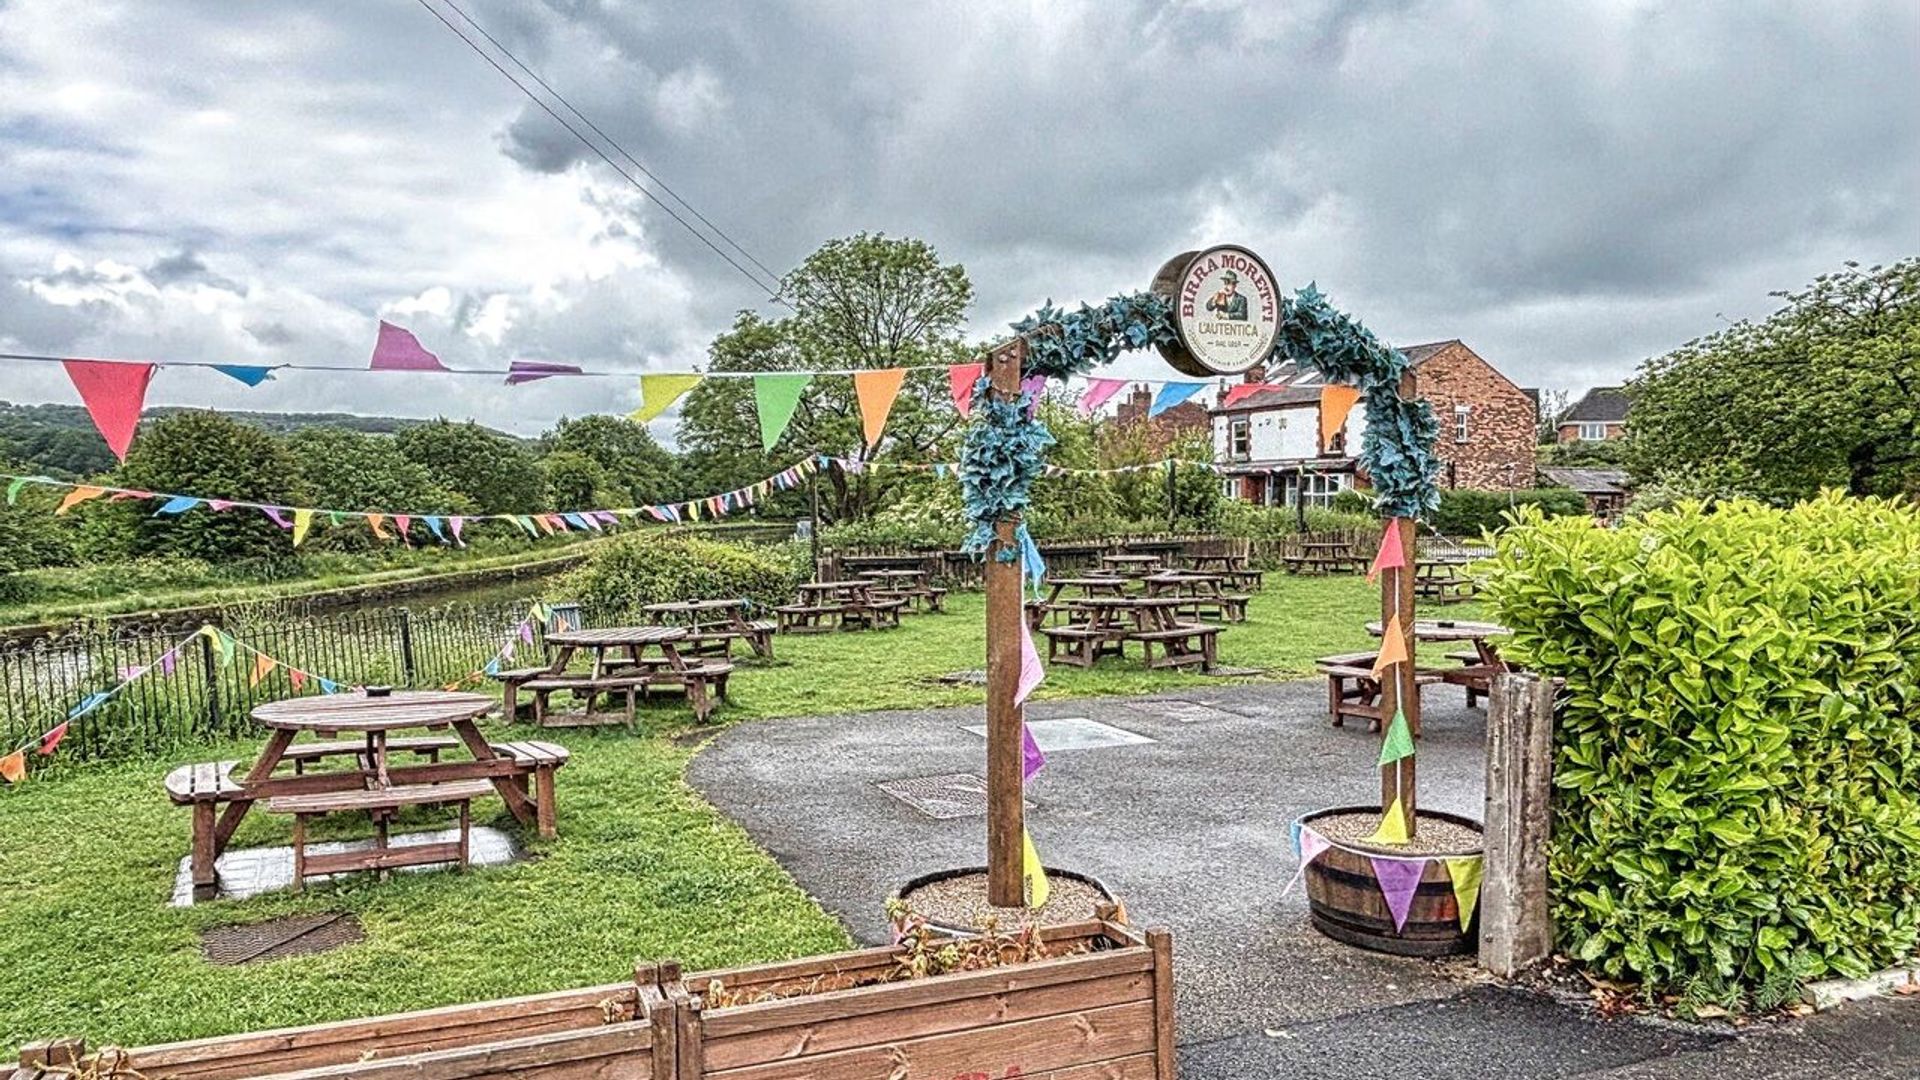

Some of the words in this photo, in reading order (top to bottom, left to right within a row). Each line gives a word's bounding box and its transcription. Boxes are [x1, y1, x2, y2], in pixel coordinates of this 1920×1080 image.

[1182, 258, 1219, 318] BIRRA
[1221, 254, 1273, 322] MORETTI
[1198, 322, 1258, 337] L'AUTENTICA
